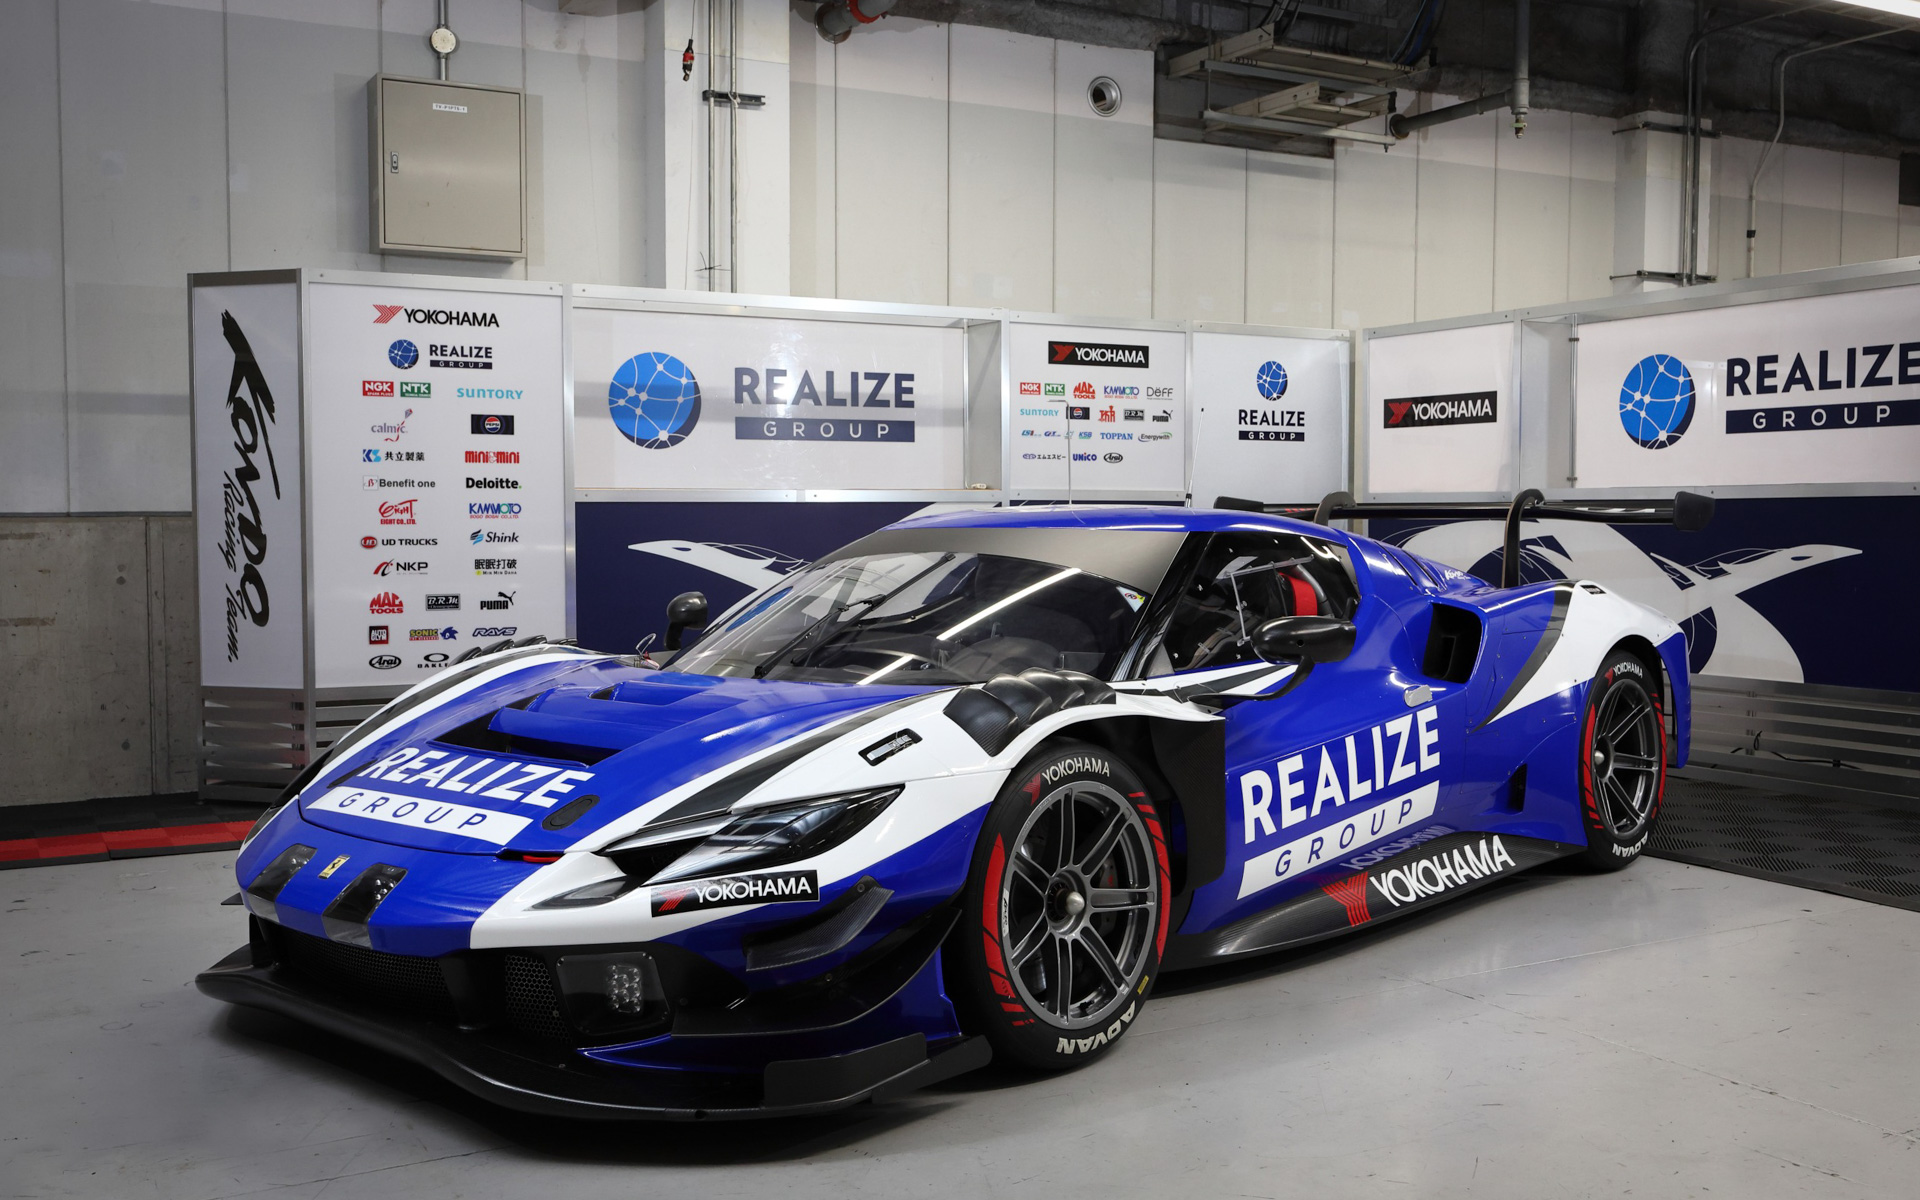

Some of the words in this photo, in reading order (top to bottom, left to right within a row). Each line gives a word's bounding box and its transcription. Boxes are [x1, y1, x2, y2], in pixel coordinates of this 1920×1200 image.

[404, 308, 500, 328] YOKOHAMA
[429, 344, 493, 359] REALIZE
[1075, 347, 1145, 363] YOKOHAMA
[1726, 341, 1920, 396] REALIZE
[365, 382, 391, 392] NGK
[402, 383, 429, 393] NTK
[457, 387, 523, 400] SUNTORY
[735, 366, 915, 409] REALIZE
[1021, 383, 1039, 391] NGK
[1046, 384, 1064, 392] NTK
[1073, 381, 1096, 394] MAC
[1412, 399, 1492, 420] YOKOHAMA
[1753, 405, 1890, 429] GROUP
[1239, 409, 1305, 426] REALIZE
[371, 423, 406, 433] calmic
[763, 421, 890, 438] GROUP
[1248, 431, 1296, 440] GROUP
[1100, 432, 1133, 440] TOPPAN
[385, 453, 425, 462] 共立製薬
[380, 478, 415, 488] Benefit
[418, 480, 436, 488] one
[216, 470, 245, 574] Racing
[381, 538, 396, 546] UD
[398, 538, 438, 546] TRUCKS
[485, 531, 519, 543] Shink
[396, 561, 429, 572] NKP
[474, 558, 517, 570] 眠眠打破
[370, 592, 404, 608] MAC
[480, 600, 509, 610] PUMA
[409, 629, 439, 637] SONIC
[473, 627, 517, 637] RAYS
[371, 656, 398, 666] Arai
[1613, 661, 1643, 679] YOKOHAMA
[357, 748, 595, 807] REALIZE
[1042, 757, 1110, 785] YOKOHAMA
[1240, 705, 1440, 844] REALIZE
[338, 792, 488, 830] GROUP
[1275, 799, 1412, 877] GROUP
[1612, 831, 1648, 858] ADVAN
[1369, 835, 1516, 907] YOKOHAMA
[695, 877, 812, 903] YOKOHAMA
[1056, 1000, 1136, 1055] ADVAN
